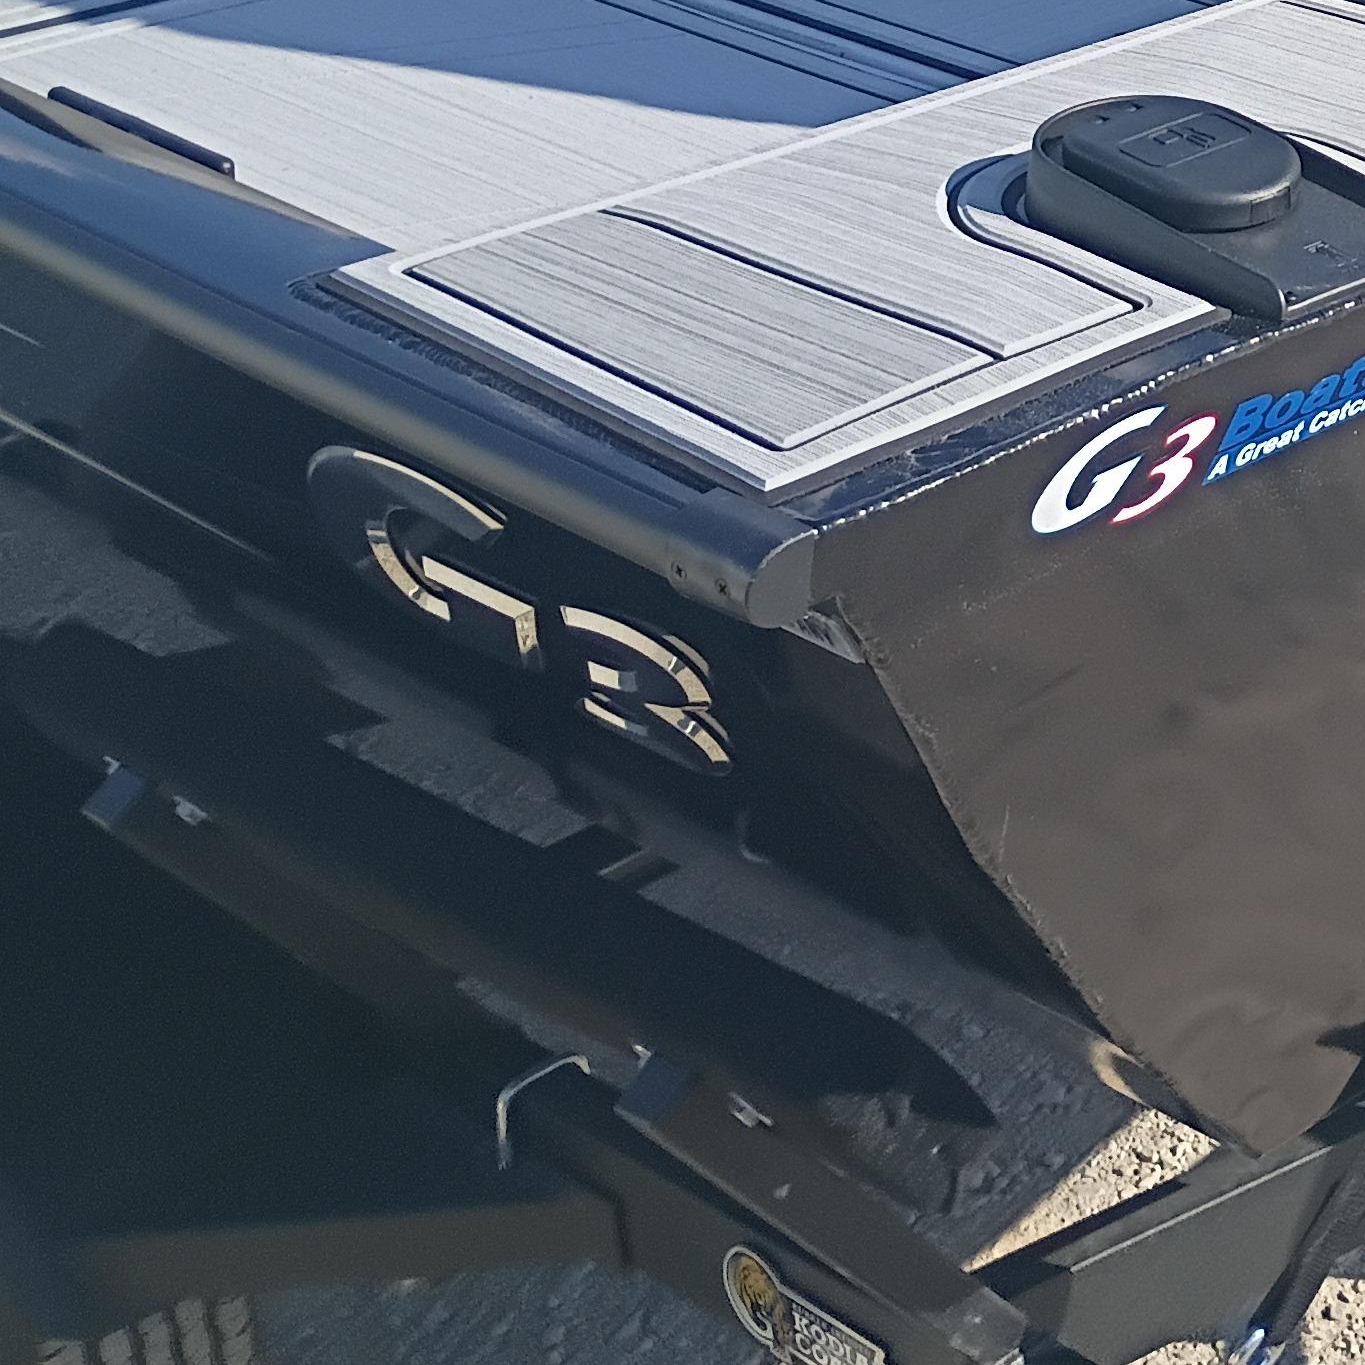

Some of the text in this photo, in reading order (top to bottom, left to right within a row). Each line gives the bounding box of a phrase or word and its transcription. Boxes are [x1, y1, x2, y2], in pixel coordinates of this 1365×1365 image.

[1032, 402, 1218, 534] G3
[1208, 454, 1229, 480] A
[1235, 422, 1304, 466] Great
[306, 445, 732, 776] G3
